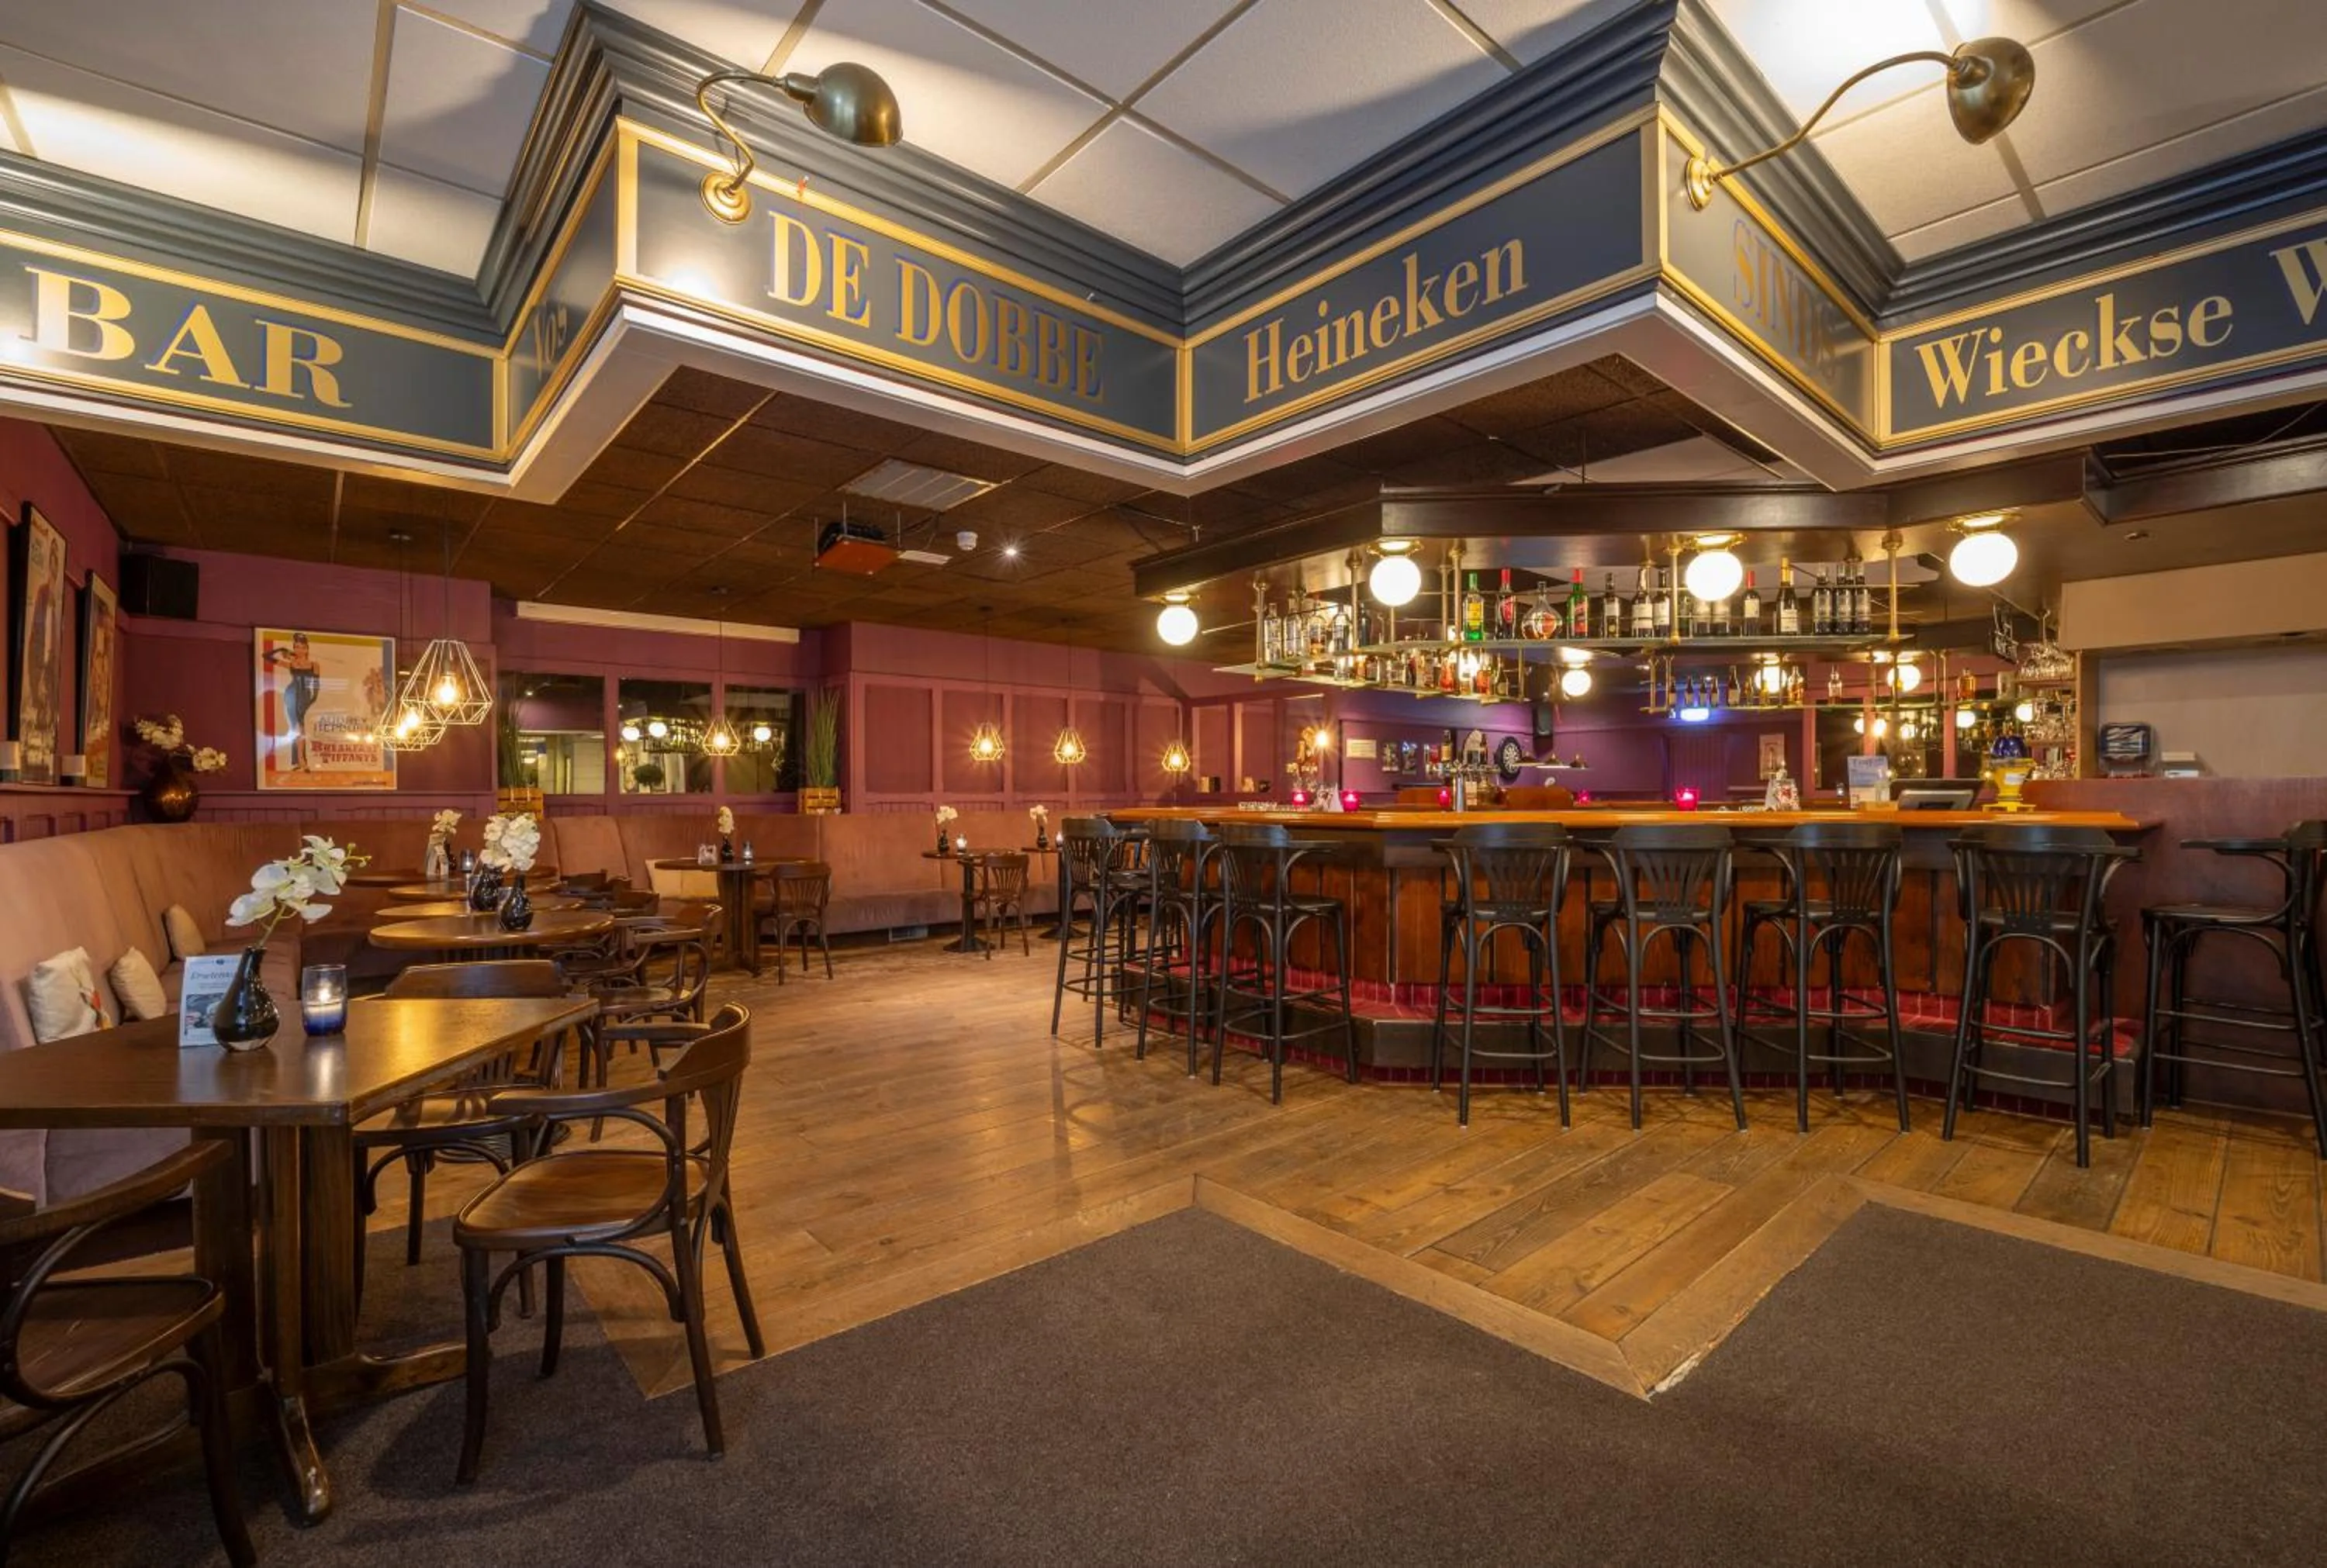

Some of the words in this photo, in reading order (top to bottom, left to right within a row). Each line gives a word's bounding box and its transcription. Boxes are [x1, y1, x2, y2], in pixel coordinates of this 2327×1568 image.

[19, 262, 352, 408] BAR
[767, 211, 871, 328] DE
[893, 254, 1106, 403] DOBBE
[1243, 238, 1528, 404] Heineken
[1914, 293, 2233, 409] Wieckse
